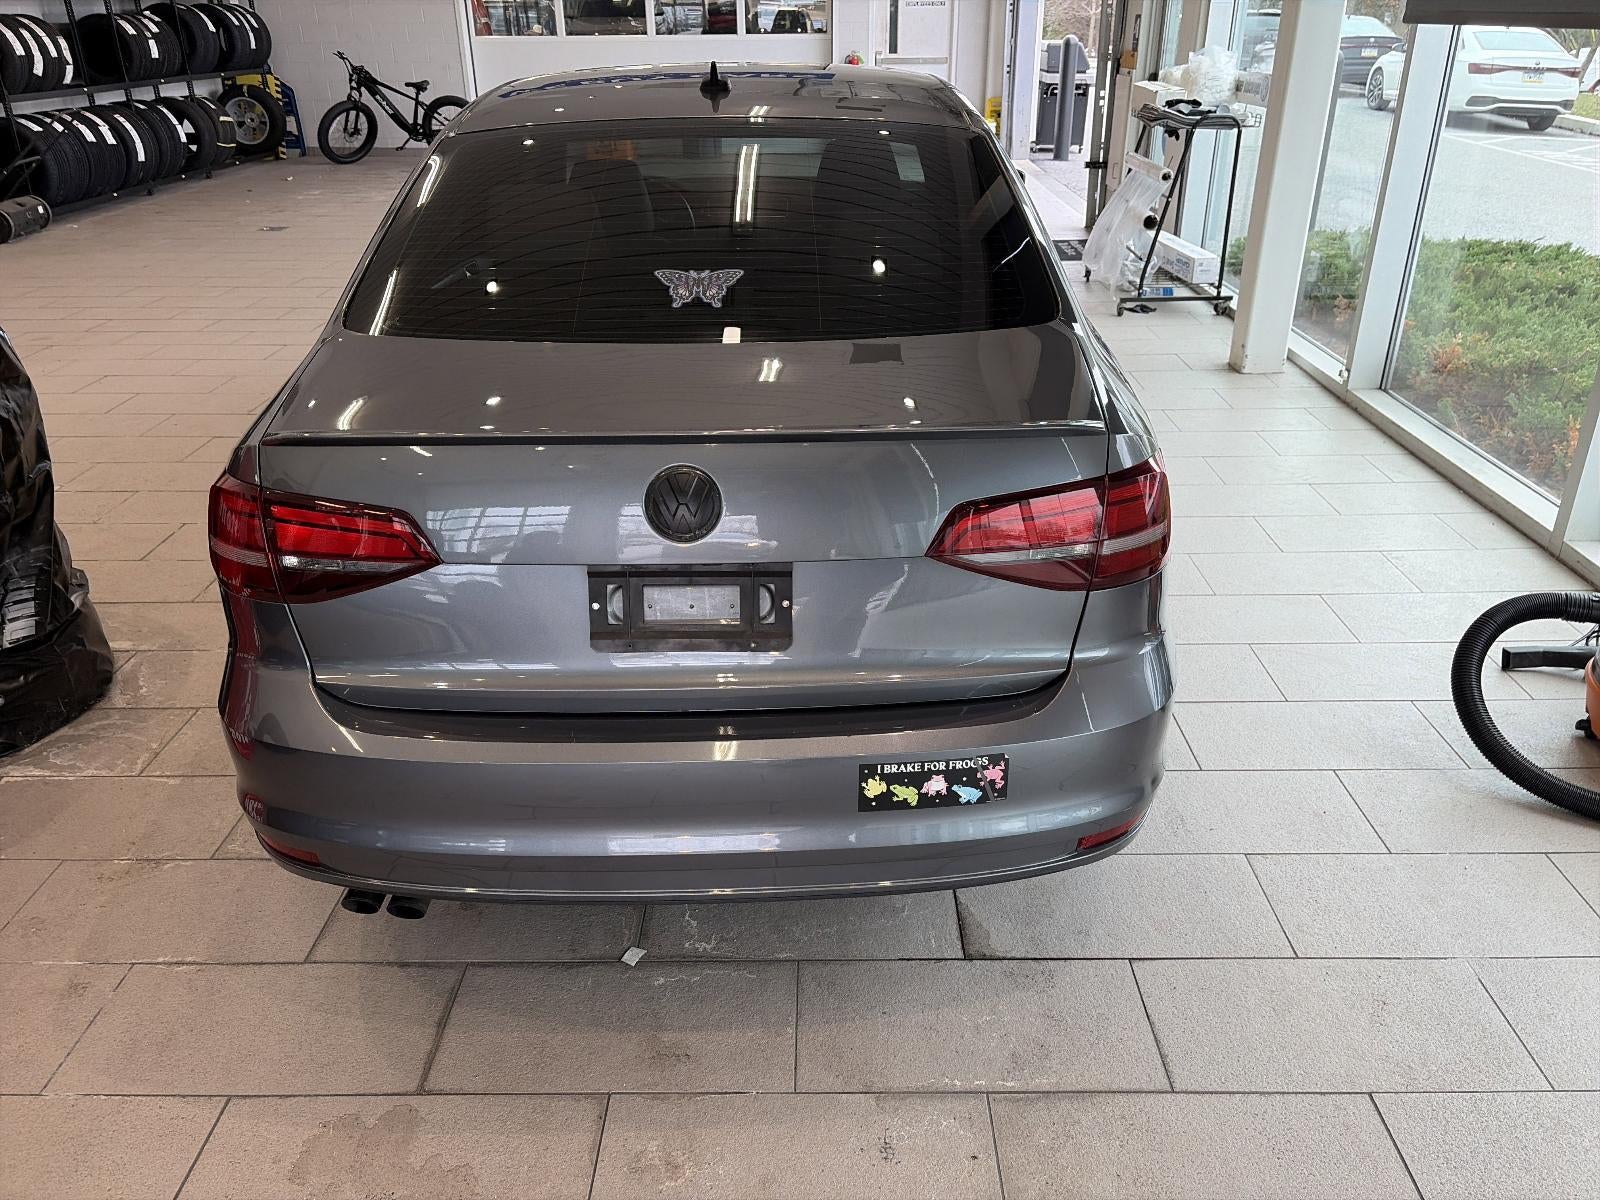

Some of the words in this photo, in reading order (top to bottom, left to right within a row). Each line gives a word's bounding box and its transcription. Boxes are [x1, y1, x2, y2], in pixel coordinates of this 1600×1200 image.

[649, 469, 717, 537] VW
[877, 765, 881, 774] I
[883, 763, 922, 774] BRAKE
[924, 761, 947, 772] FOR
